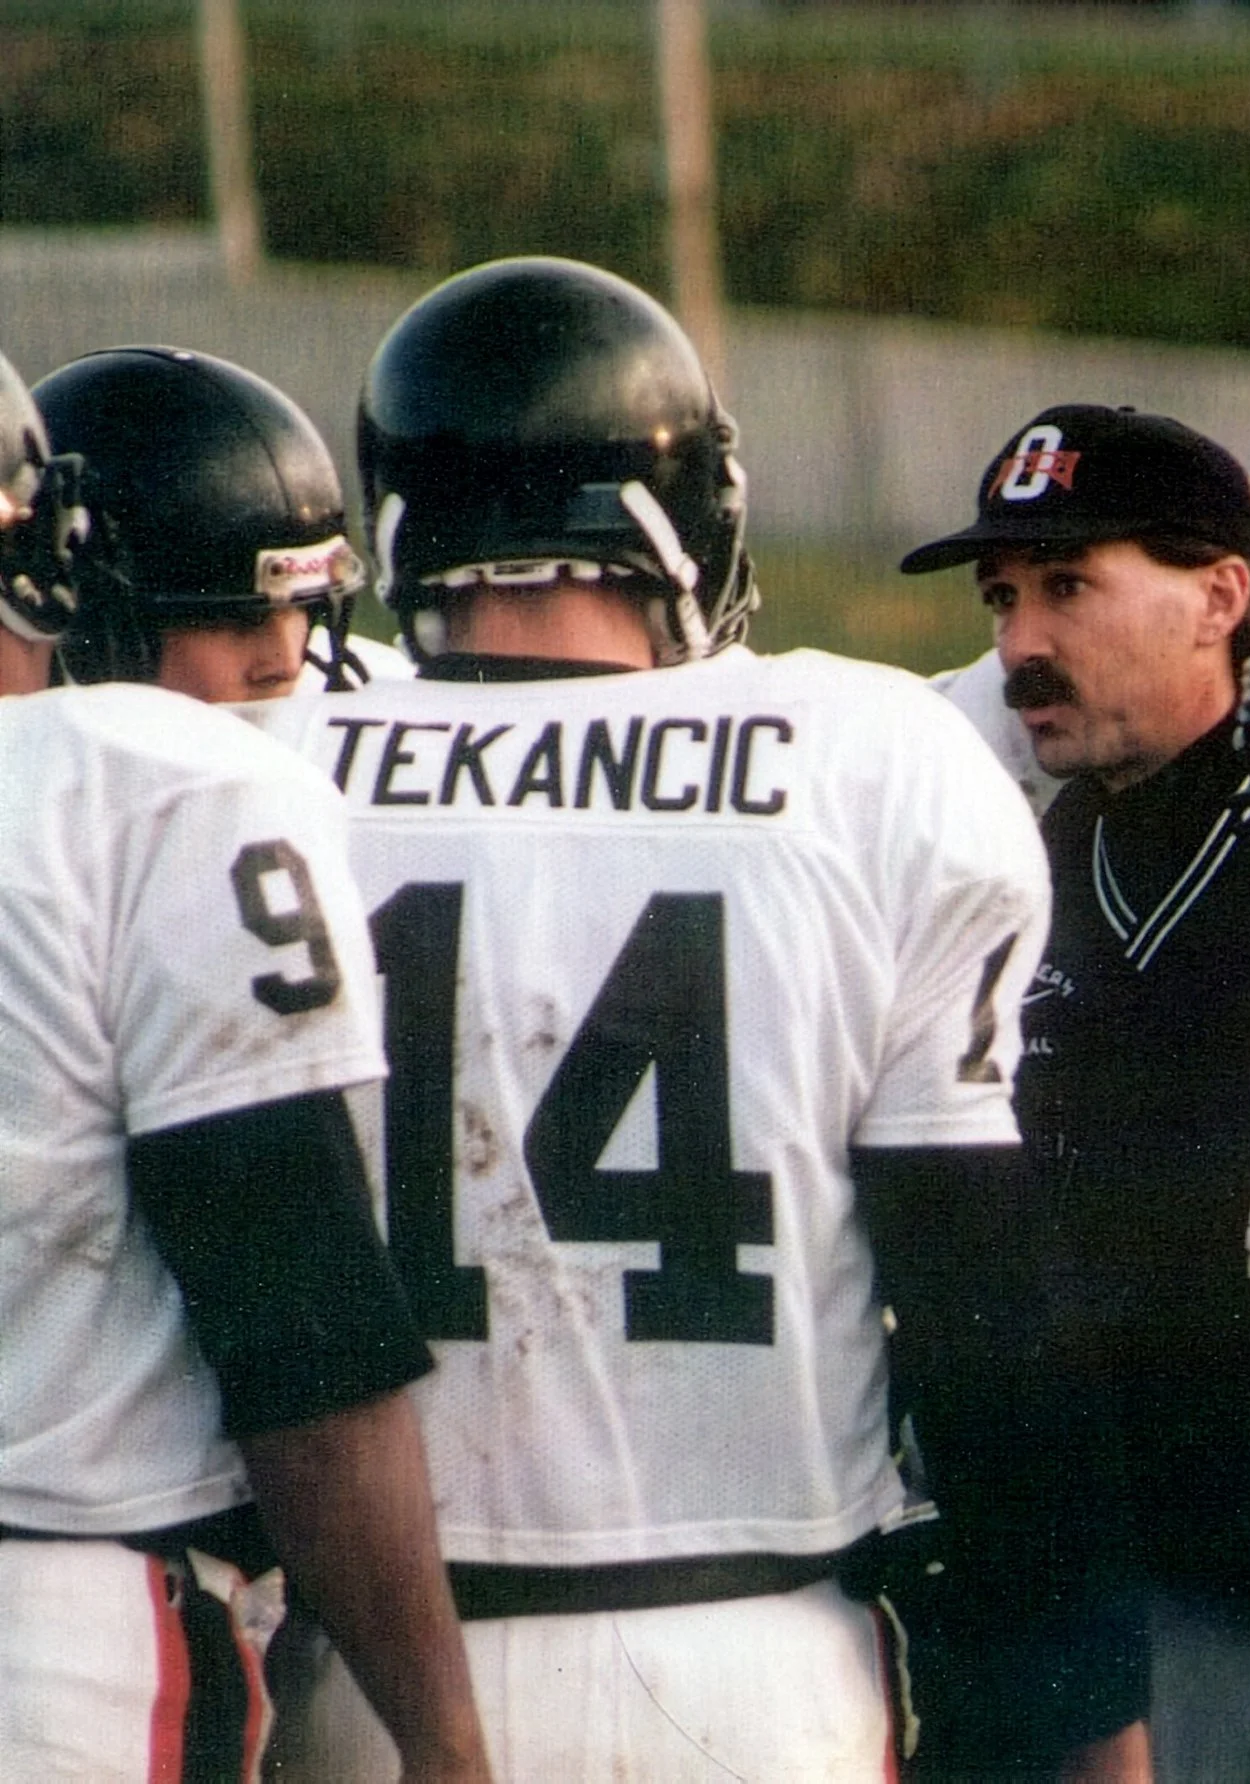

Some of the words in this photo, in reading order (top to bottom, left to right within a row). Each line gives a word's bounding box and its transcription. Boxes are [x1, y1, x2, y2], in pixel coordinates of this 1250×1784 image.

[327, 714, 794, 818] TEKANCIC
[229, 837, 343, 1016] 9
[366, 879, 778, 1347] 14
